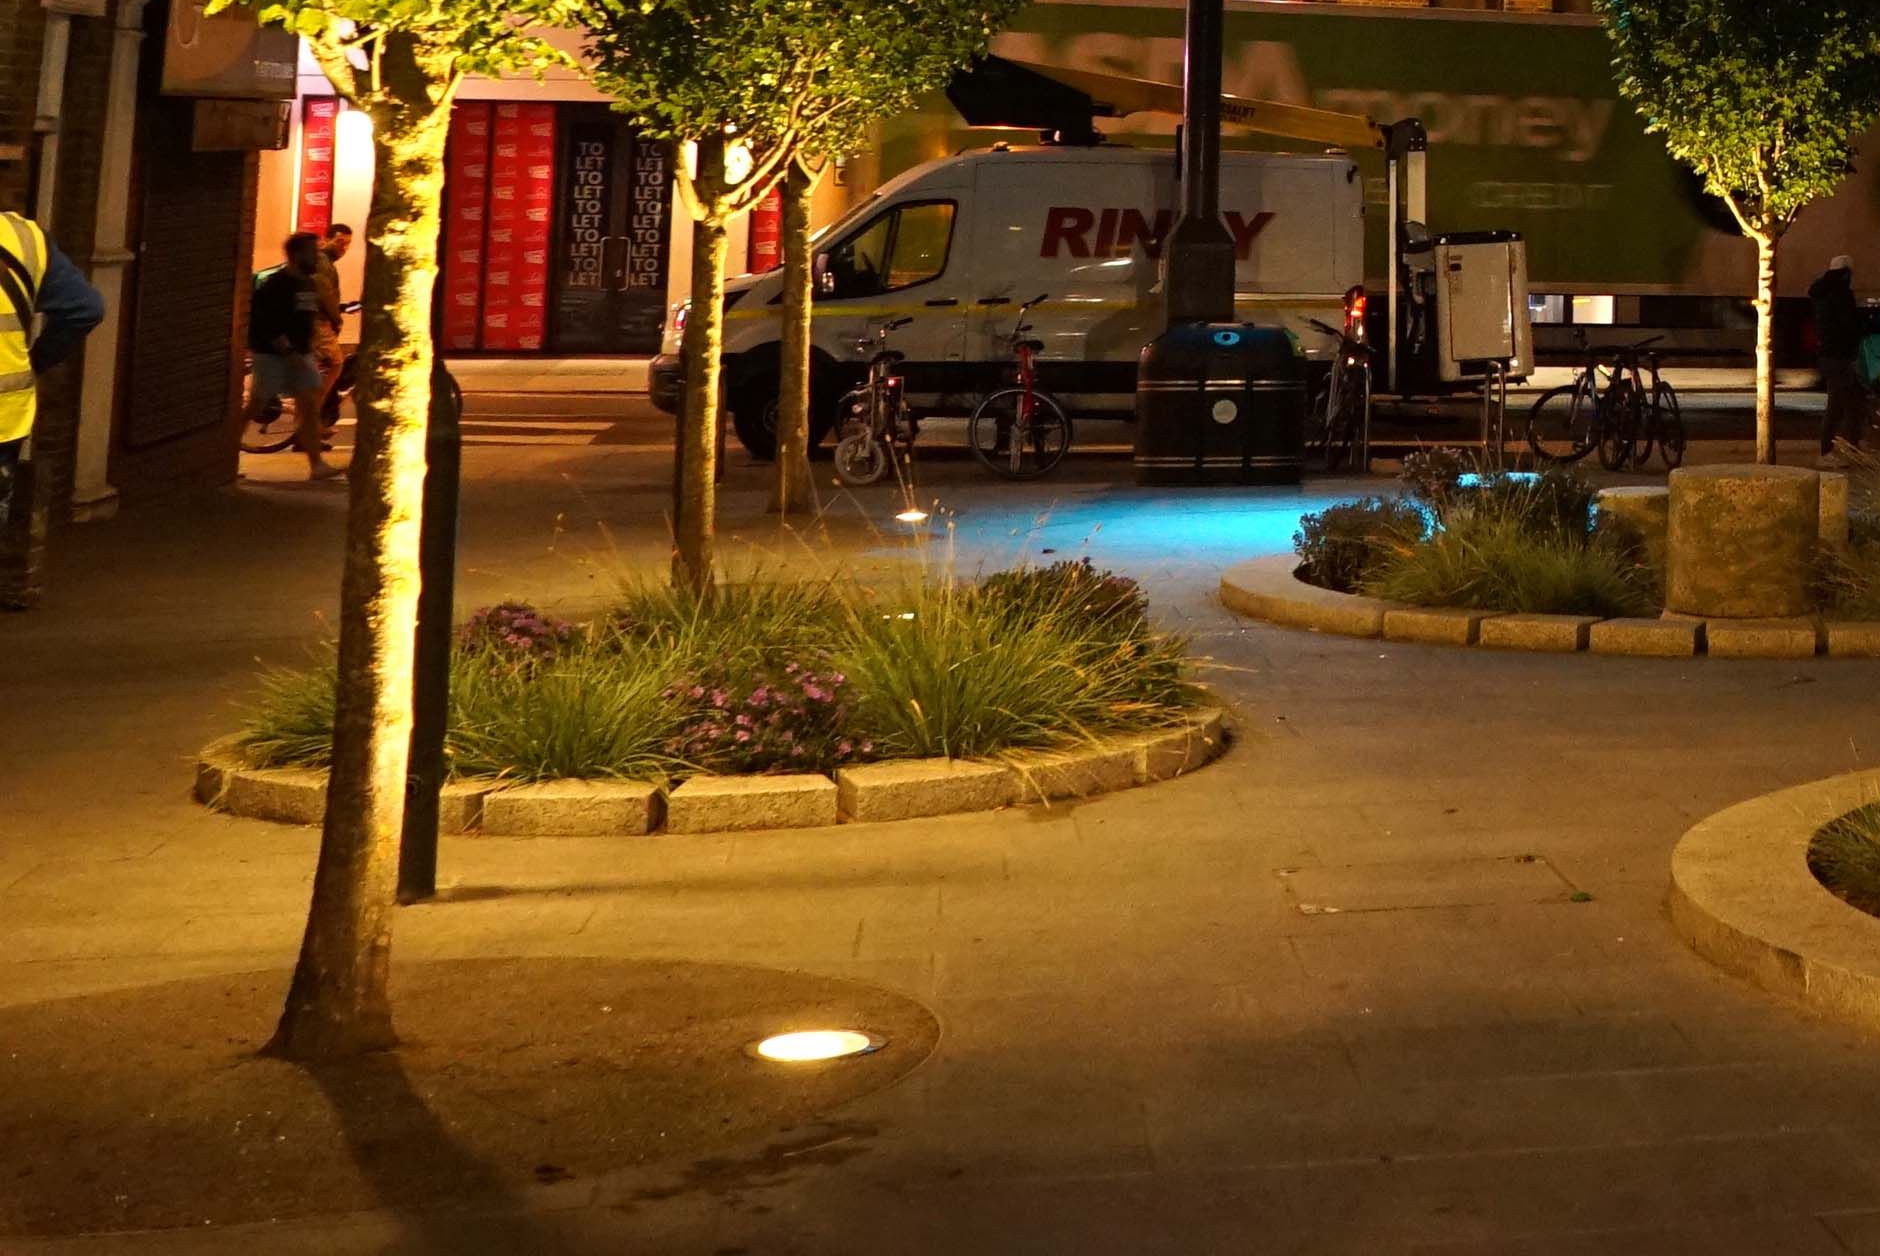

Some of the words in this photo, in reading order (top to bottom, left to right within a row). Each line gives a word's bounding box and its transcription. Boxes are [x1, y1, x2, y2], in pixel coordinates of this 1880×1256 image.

[580, 142, 604, 156] TO
[576, 156, 605, 170] LET
[636, 157, 664, 171] LET
[577, 171, 602, 185] TO
[637, 172, 663, 185] TO
[574, 185, 604, 199] LET
[634, 186, 664, 199] LET
[575, 200, 601, 214] TO
[636, 201, 663, 214] TO
[571, 214, 602, 228] LET
[633, 215, 663, 228] LET
[574, 229, 599, 242] TO
[634, 230, 660, 243] TO
[1040, 207, 1277, 260] RINY
[570, 243, 600, 257] LET
[632, 244, 660, 257] LET
[572, 258, 598, 272] TO
[633, 258, 658, 272] TO
[568, 272, 599, 286] LET
[630, 273, 659, 286] LET
